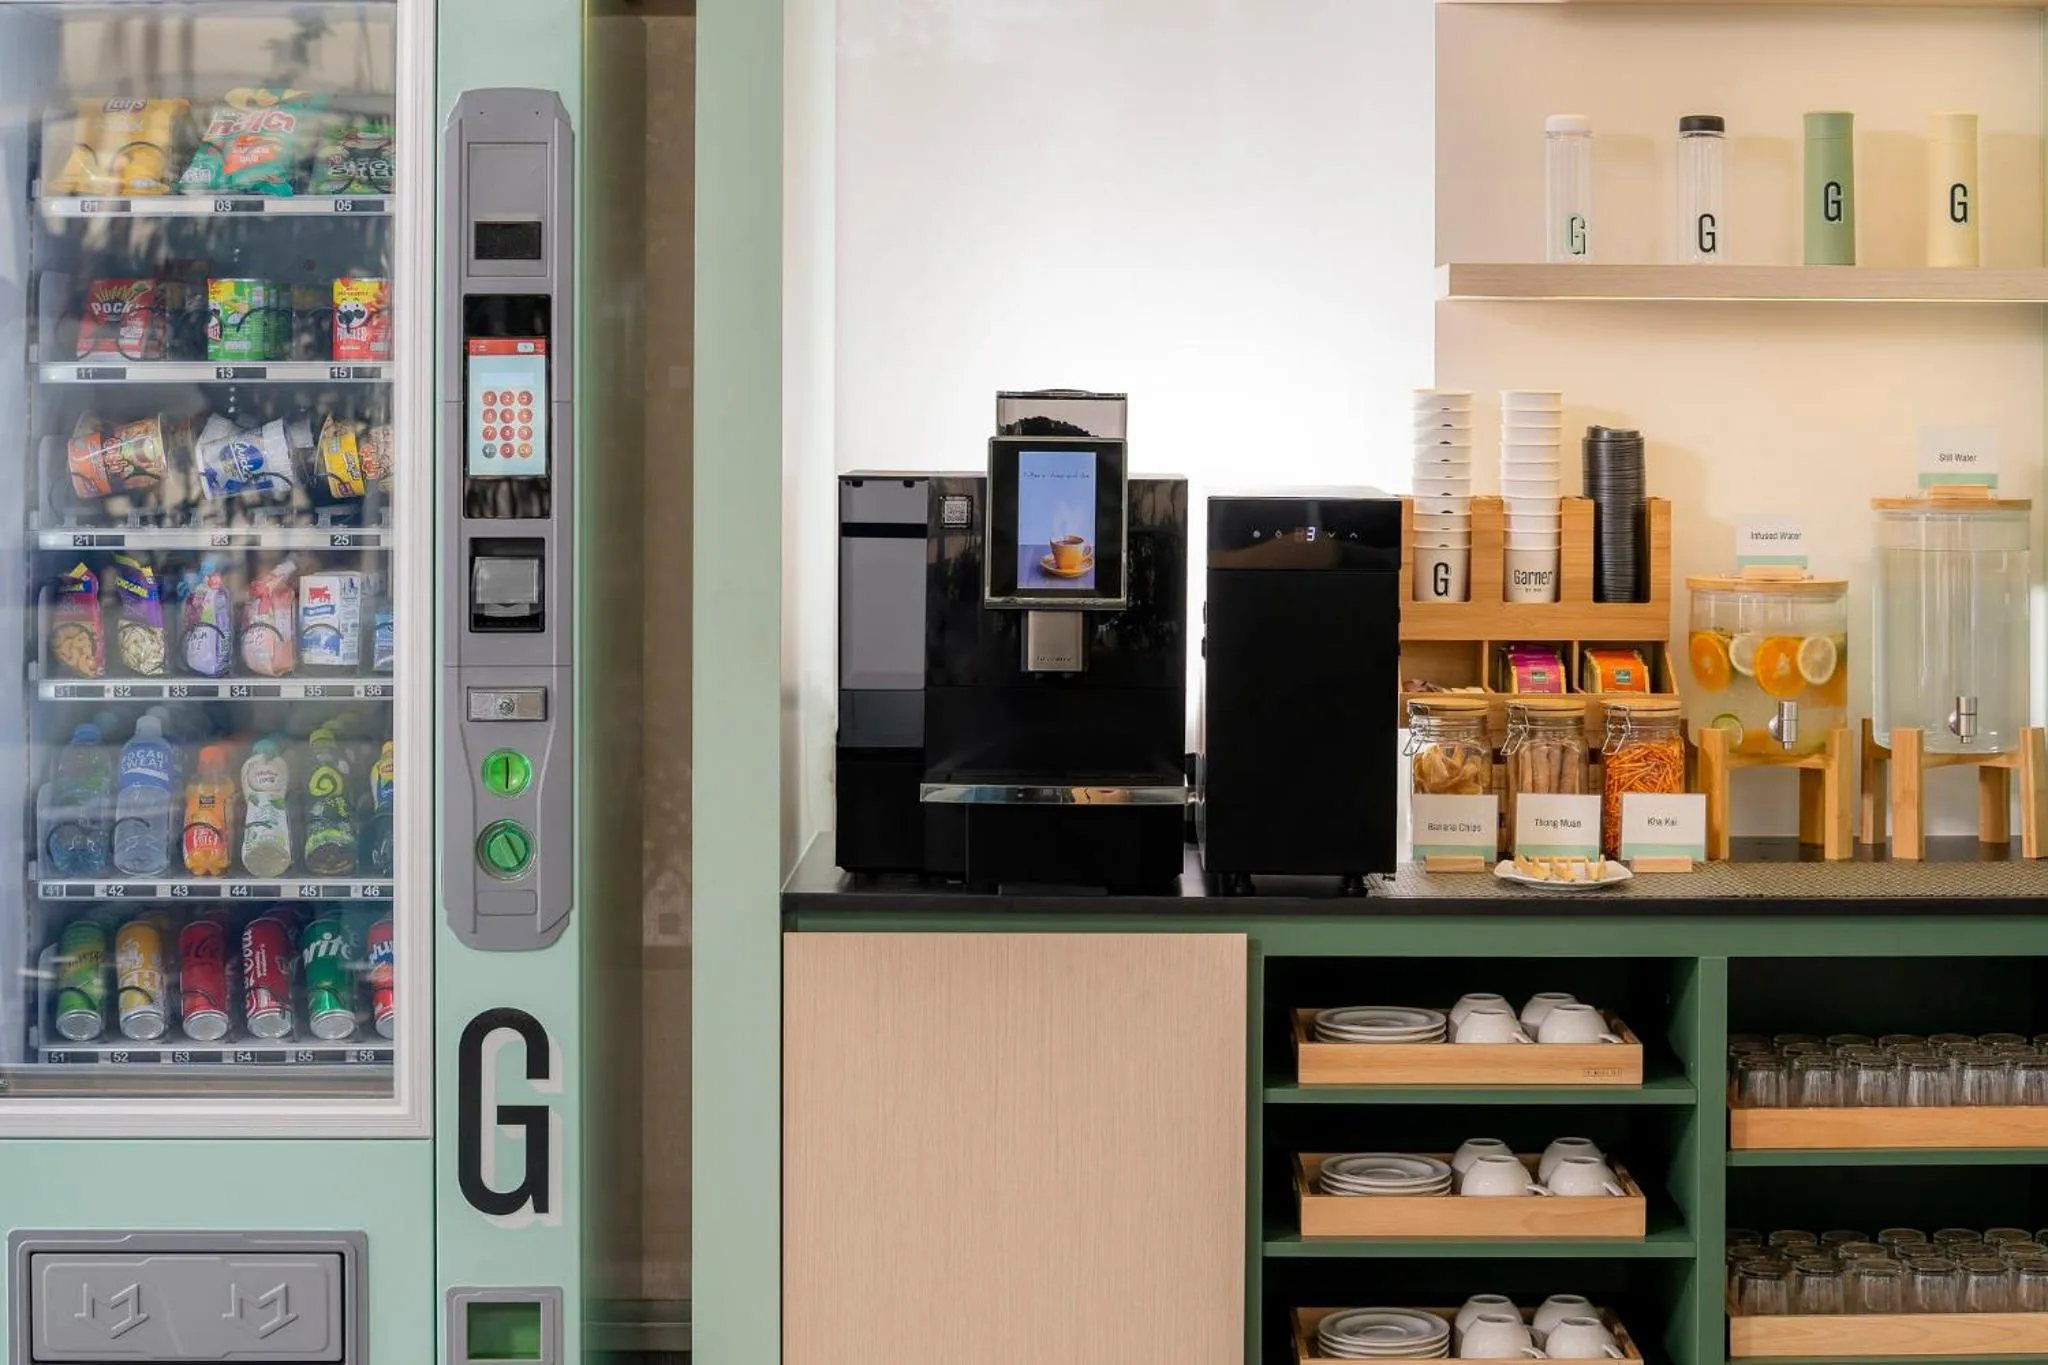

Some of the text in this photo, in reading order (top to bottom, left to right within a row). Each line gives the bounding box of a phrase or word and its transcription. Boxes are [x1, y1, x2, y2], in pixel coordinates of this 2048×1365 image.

[216, 201, 232, 212] 03
[337, 201, 352, 212] 05
[1823, 181, 1843, 222] G
[1950, 183, 1968, 223] G
[1698, 213, 1716, 253] G
[219, 368, 234, 379] 13
[332, 368, 347, 379] 15
[1954, 453, 1977, 462] Water
[1305, 526, 1317, 542] 3
[1750, 531, 1802, 540] Infused Water
[75, 535, 90, 546] 21
[213, 535, 229, 546] 23
[334, 535, 349, 546] 25
[1432, 562, 1450, 597] G
[1513, 569, 1553, 585] Garner
[56, 686, 70, 697] 31
[115, 686, 131, 697] 32
[172, 686, 188, 697] 33
[232, 686, 248, 697] 34
[306, 686, 322, 697] 35
[367, 686, 382, 697] 36
[45, 886, 60, 896] 41
[108, 886, 124, 896] 42
[172, 886, 188, 896] 43
[232, 886, 248, 896] 44
[301, 886, 317, 896] 45
[364, 886, 380, 896] 46
[51, 1052, 65, 1062] 51
[113, 1052, 129, 1062] 52
[175, 1052, 190, 1062] 53
[236, 1052, 252, 1062] 54
[298, 1052, 313, 1062] 55
[359, 1052, 375, 1062] 56
[458, 1007, 550, 1216] G
